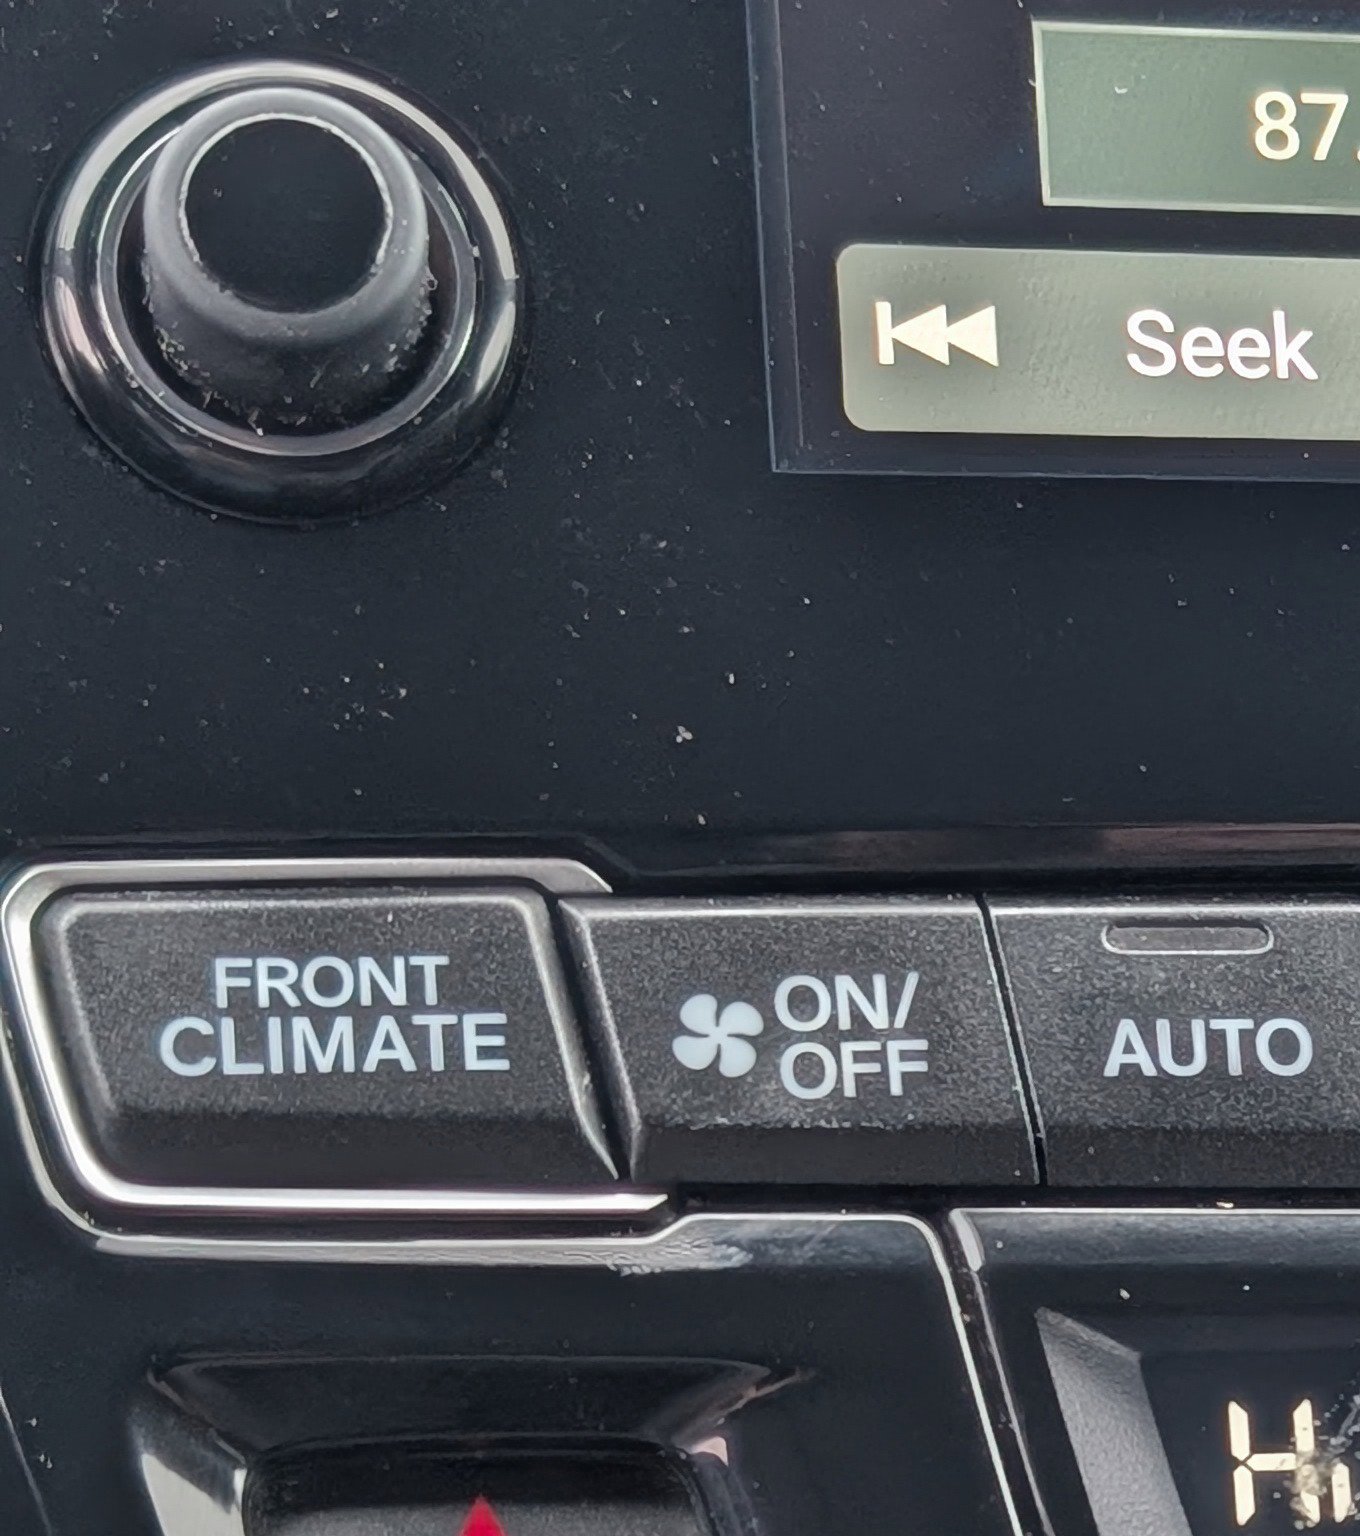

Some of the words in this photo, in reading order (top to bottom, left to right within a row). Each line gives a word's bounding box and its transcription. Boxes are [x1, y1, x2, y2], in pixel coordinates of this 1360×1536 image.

[1125, 308, 1319, 383] Seek
[214, 955, 449, 1009] FRONT
[774, 971, 919, 1032] ON/
[159, 1012, 510, 1078] CLIMATE
[780, 1038, 929, 1100] OFF
[1103, 1018, 1312, 1077] AUTO
